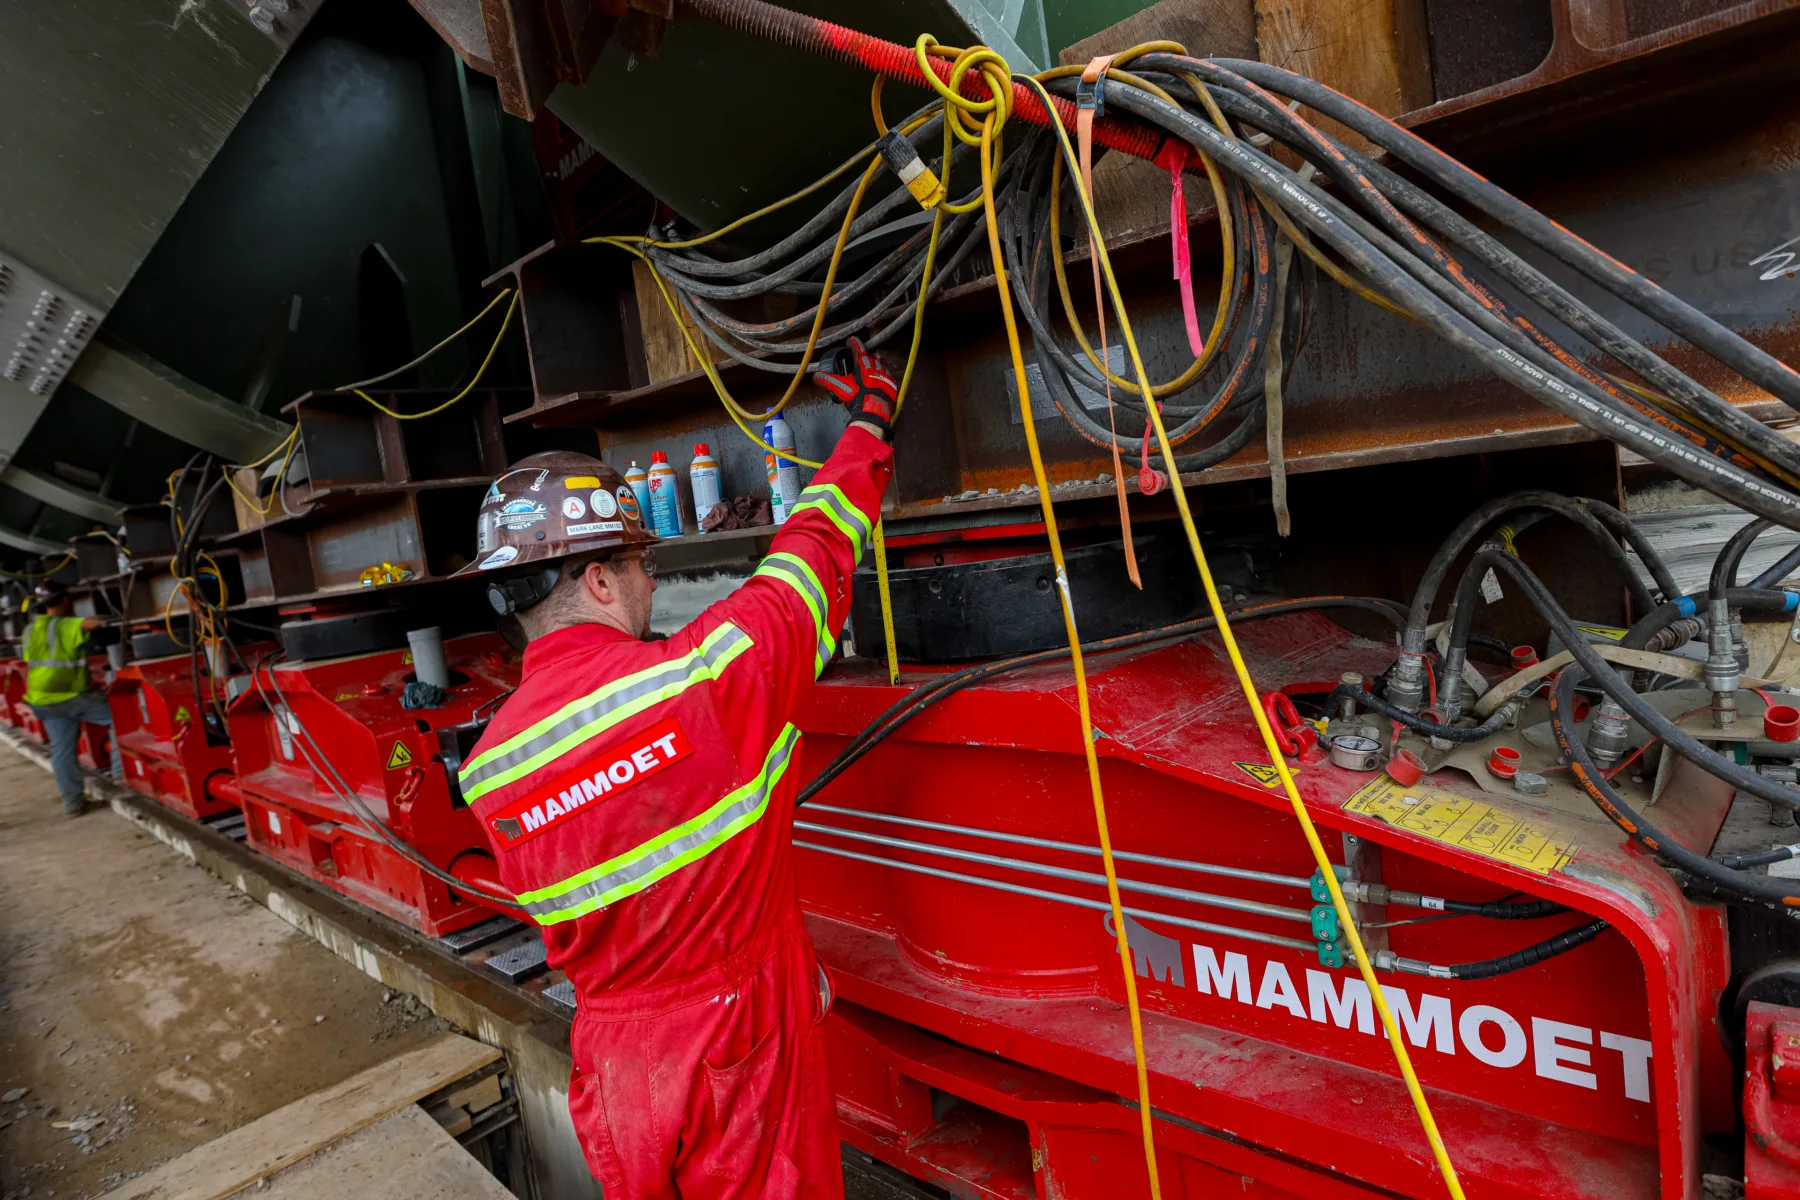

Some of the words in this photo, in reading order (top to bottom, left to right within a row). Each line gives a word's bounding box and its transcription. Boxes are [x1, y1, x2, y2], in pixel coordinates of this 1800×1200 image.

[1495, 347, 1516, 363] ITALY
[1522, 363, 1544, 380] MADE
[1602, 409, 1613, 419] 12
[1653, 435, 1666, 447] EN
[1698, 458, 1715, 471] SAE
[1758, 485, 1791, 506] FLEXOR
[569, 502, 581, 514] A
[520, 732, 676, 833] MAMMOET
[1191, 943, 1653, 1104] MAMMOET
